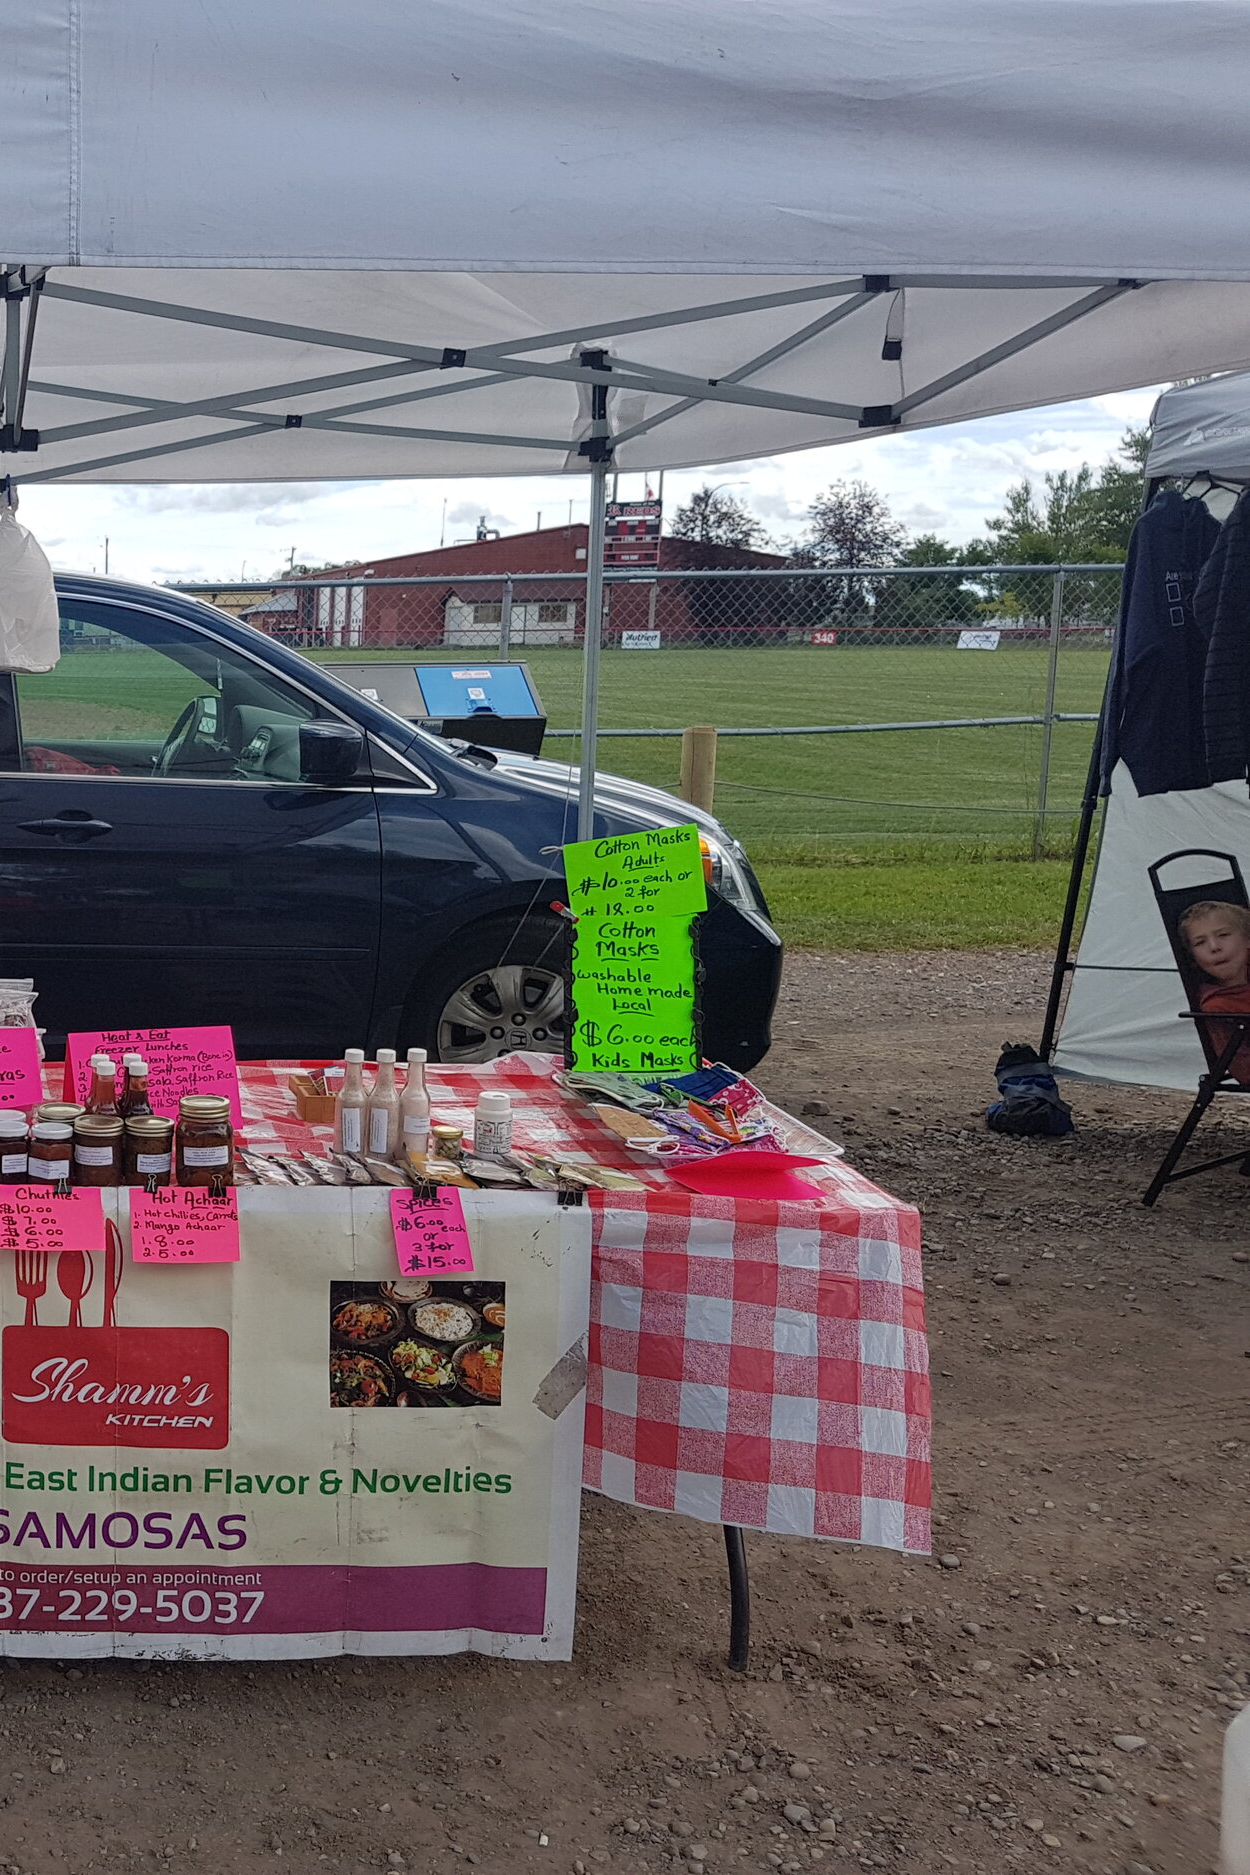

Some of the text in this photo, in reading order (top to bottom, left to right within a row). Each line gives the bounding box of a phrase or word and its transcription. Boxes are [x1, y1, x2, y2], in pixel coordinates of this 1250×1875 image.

[814, 632, 836, 644] 340
[594, 829, 691, 858] Cotton Masks
[622, 851, 665, 870] Adults
[643, 870, 673, 883] each
[677, 870, 693, 881] or
[624, 885, 661, 899] 2 for
[598, 921, 656, 939] Cotton
[595, 941, 660, 958] Masks
[577, 967, 652, 983] washable
[597, 982, 693, 998] Home made
[612, 998, 652, 1012] Local
[101, 1029, 172, 1044] Heat Eat
[659, 1028, 698, 1047] each
[94, 1042, 190, 1055] Freezer Lunches
[166, 1053, 196, 1065] Korma
[591, 1051, 684, 1069] Kids Masks
[192, 1062, 215, 1072] rice
[175, 1070, 235, 1085] Saffron Rice
[162, 1087, 200, 1099] Noodles
[15, 1186, 81, 1201] Chutnies
[152, 1190, 234, 1207] Hot Achaar
[395, 1197, 454, 1213] Spices
[144, 1209, 162, 1219] Hot
[145, 1220, 181, 1235] Mango
[185, 1221, 227, 1231] Achaar
[441, 1224, 466, 1233] each
[422, 1232, 439, 1242] or
[412, 1241, 455, 1253] 3 for
[12, 1357, 214, 1407] Shamm's
[105, 1413, 214, 1428] KITCHEN
[5, 1462, 77, 1491] East
[88, 1466, 192, 1493] Indian
[204, 1468, 310, 1495] Flavor
[320, 1469, 343, 1495] &
[352, 1466, 512, 1494] Novelties
[0, 1569, 15, 1581] to
[19, 1570, 119, 1586] order/setup
[126, 1572, 147, 1584] an
[152, 1571, 262, 1586] appointment
